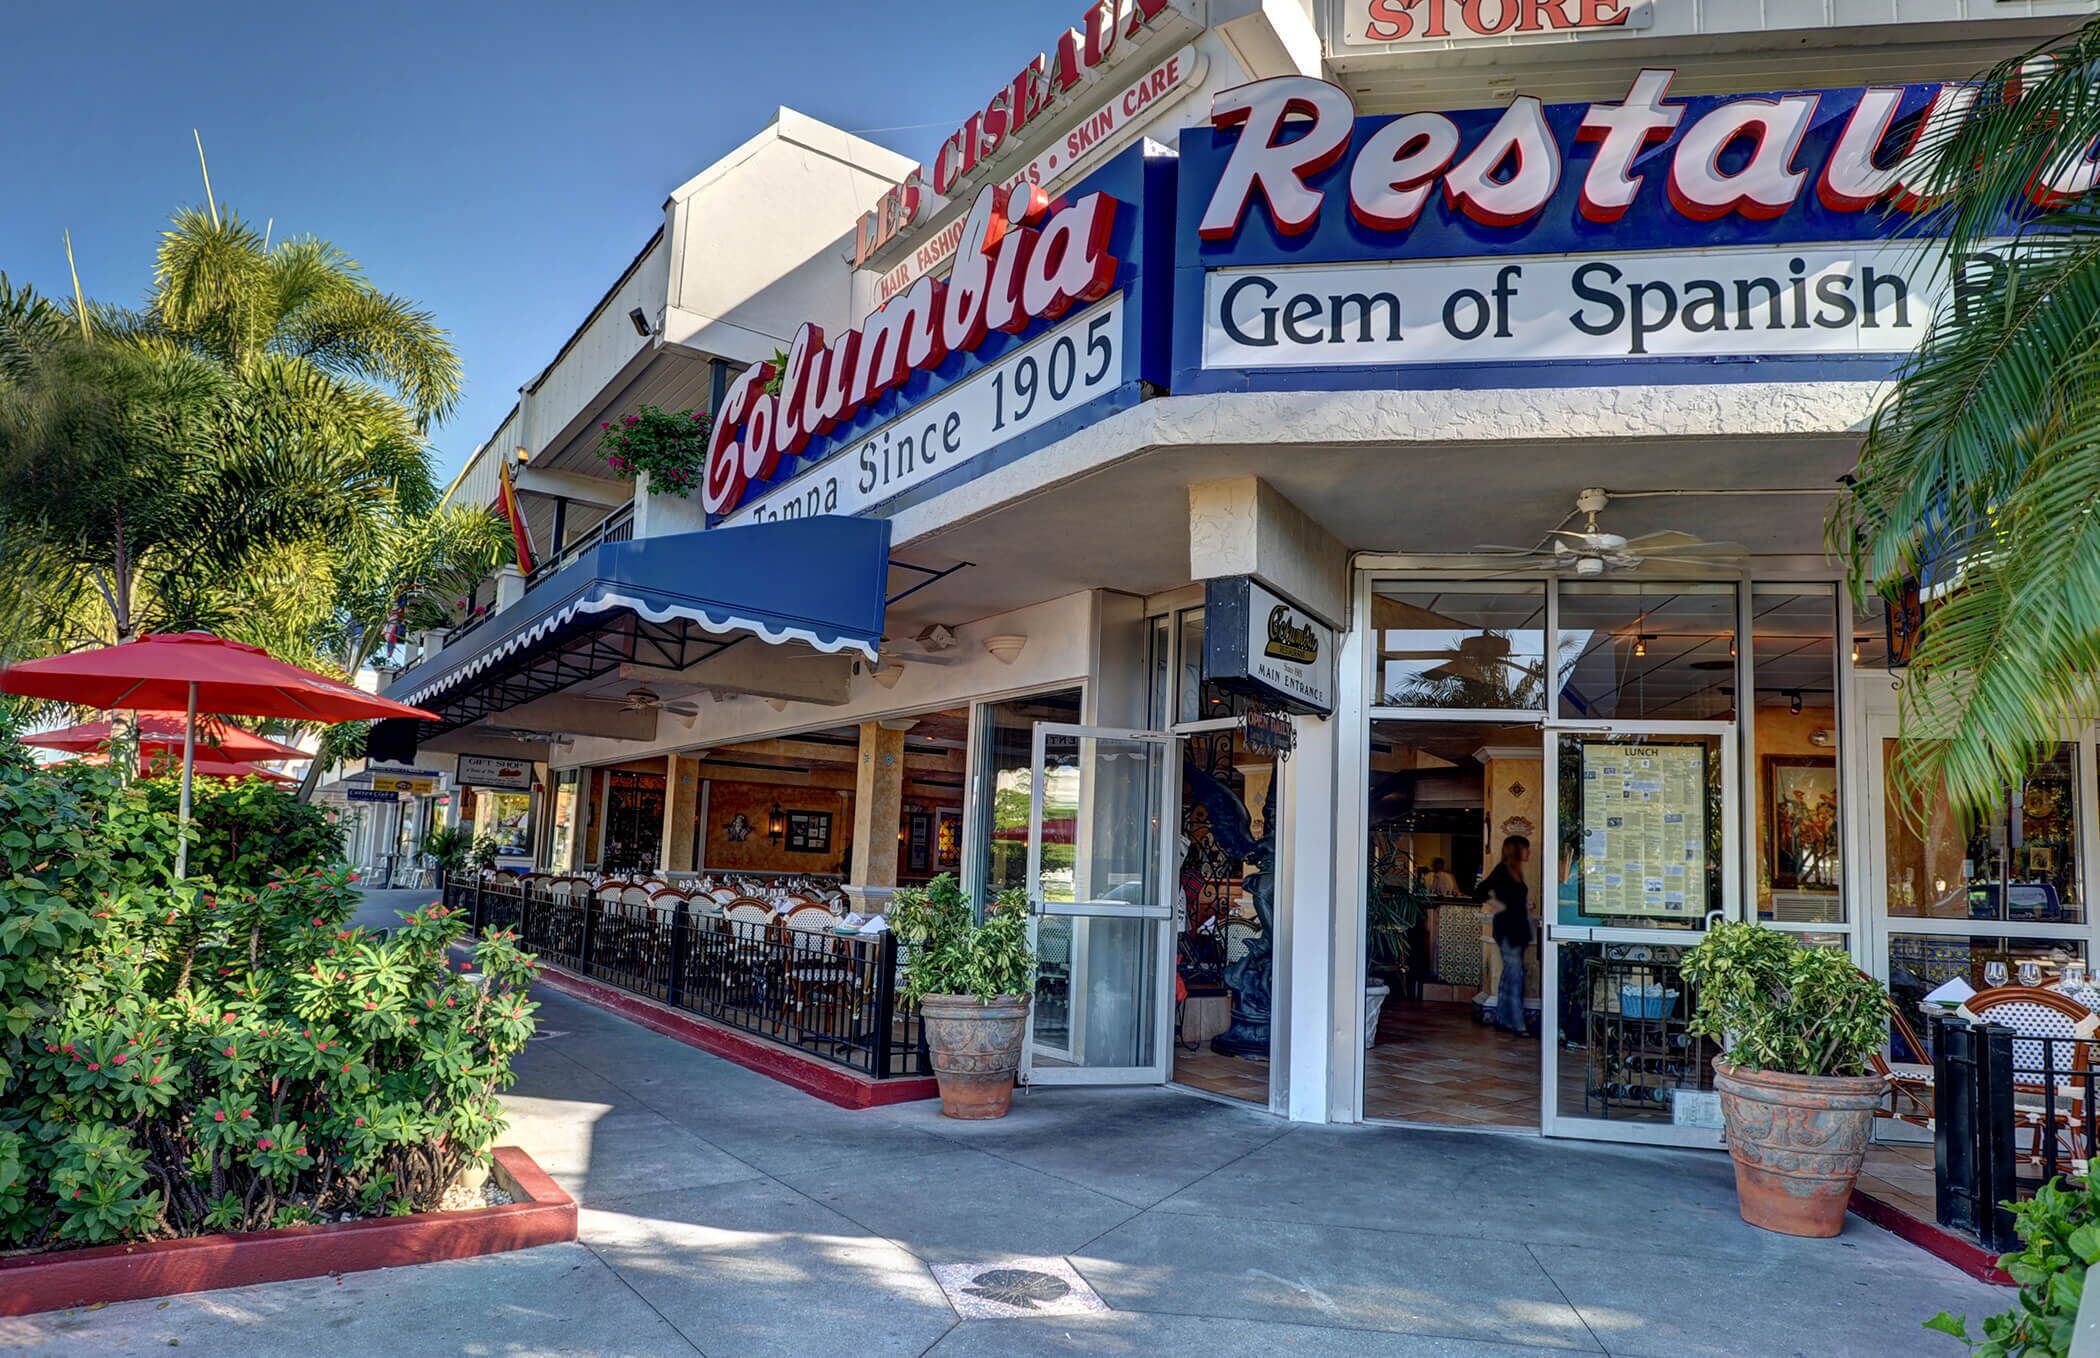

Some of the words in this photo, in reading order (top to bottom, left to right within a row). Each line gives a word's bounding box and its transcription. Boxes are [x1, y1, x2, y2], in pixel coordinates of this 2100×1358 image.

[1067, 106, 1113, 159] SKIN
[1123, 57, 1179, 117] CARE
[856, 164, 922, 266] LES
[881, 263, 910, 300] HAIR
[916, 216, 968, 272] FASHIO
[1219, 275, 1404, 347] Gem
[1442, 265, 1522, 341] of
[1570, 257, 1914, 354] Spanish
[702, 183, 1118, 514] Columbia
[858, 411, 961, 493] Since
[992, 311, 1112, 432] 1905
[1268, 604, 1319, 652] Columbia
[1248, 711, 1267, 730] OPEN
[1271, 719, 1291, 737] DAILY
[1258, 663, 1280, 684] MAIN
[1285, 676, 1324, 702] ENTRANCE
[468, 758, 494, 766] GIFT
[495, 759, 523, 769] SHOP
[1625, 748, 1659, 757] LUNCH
